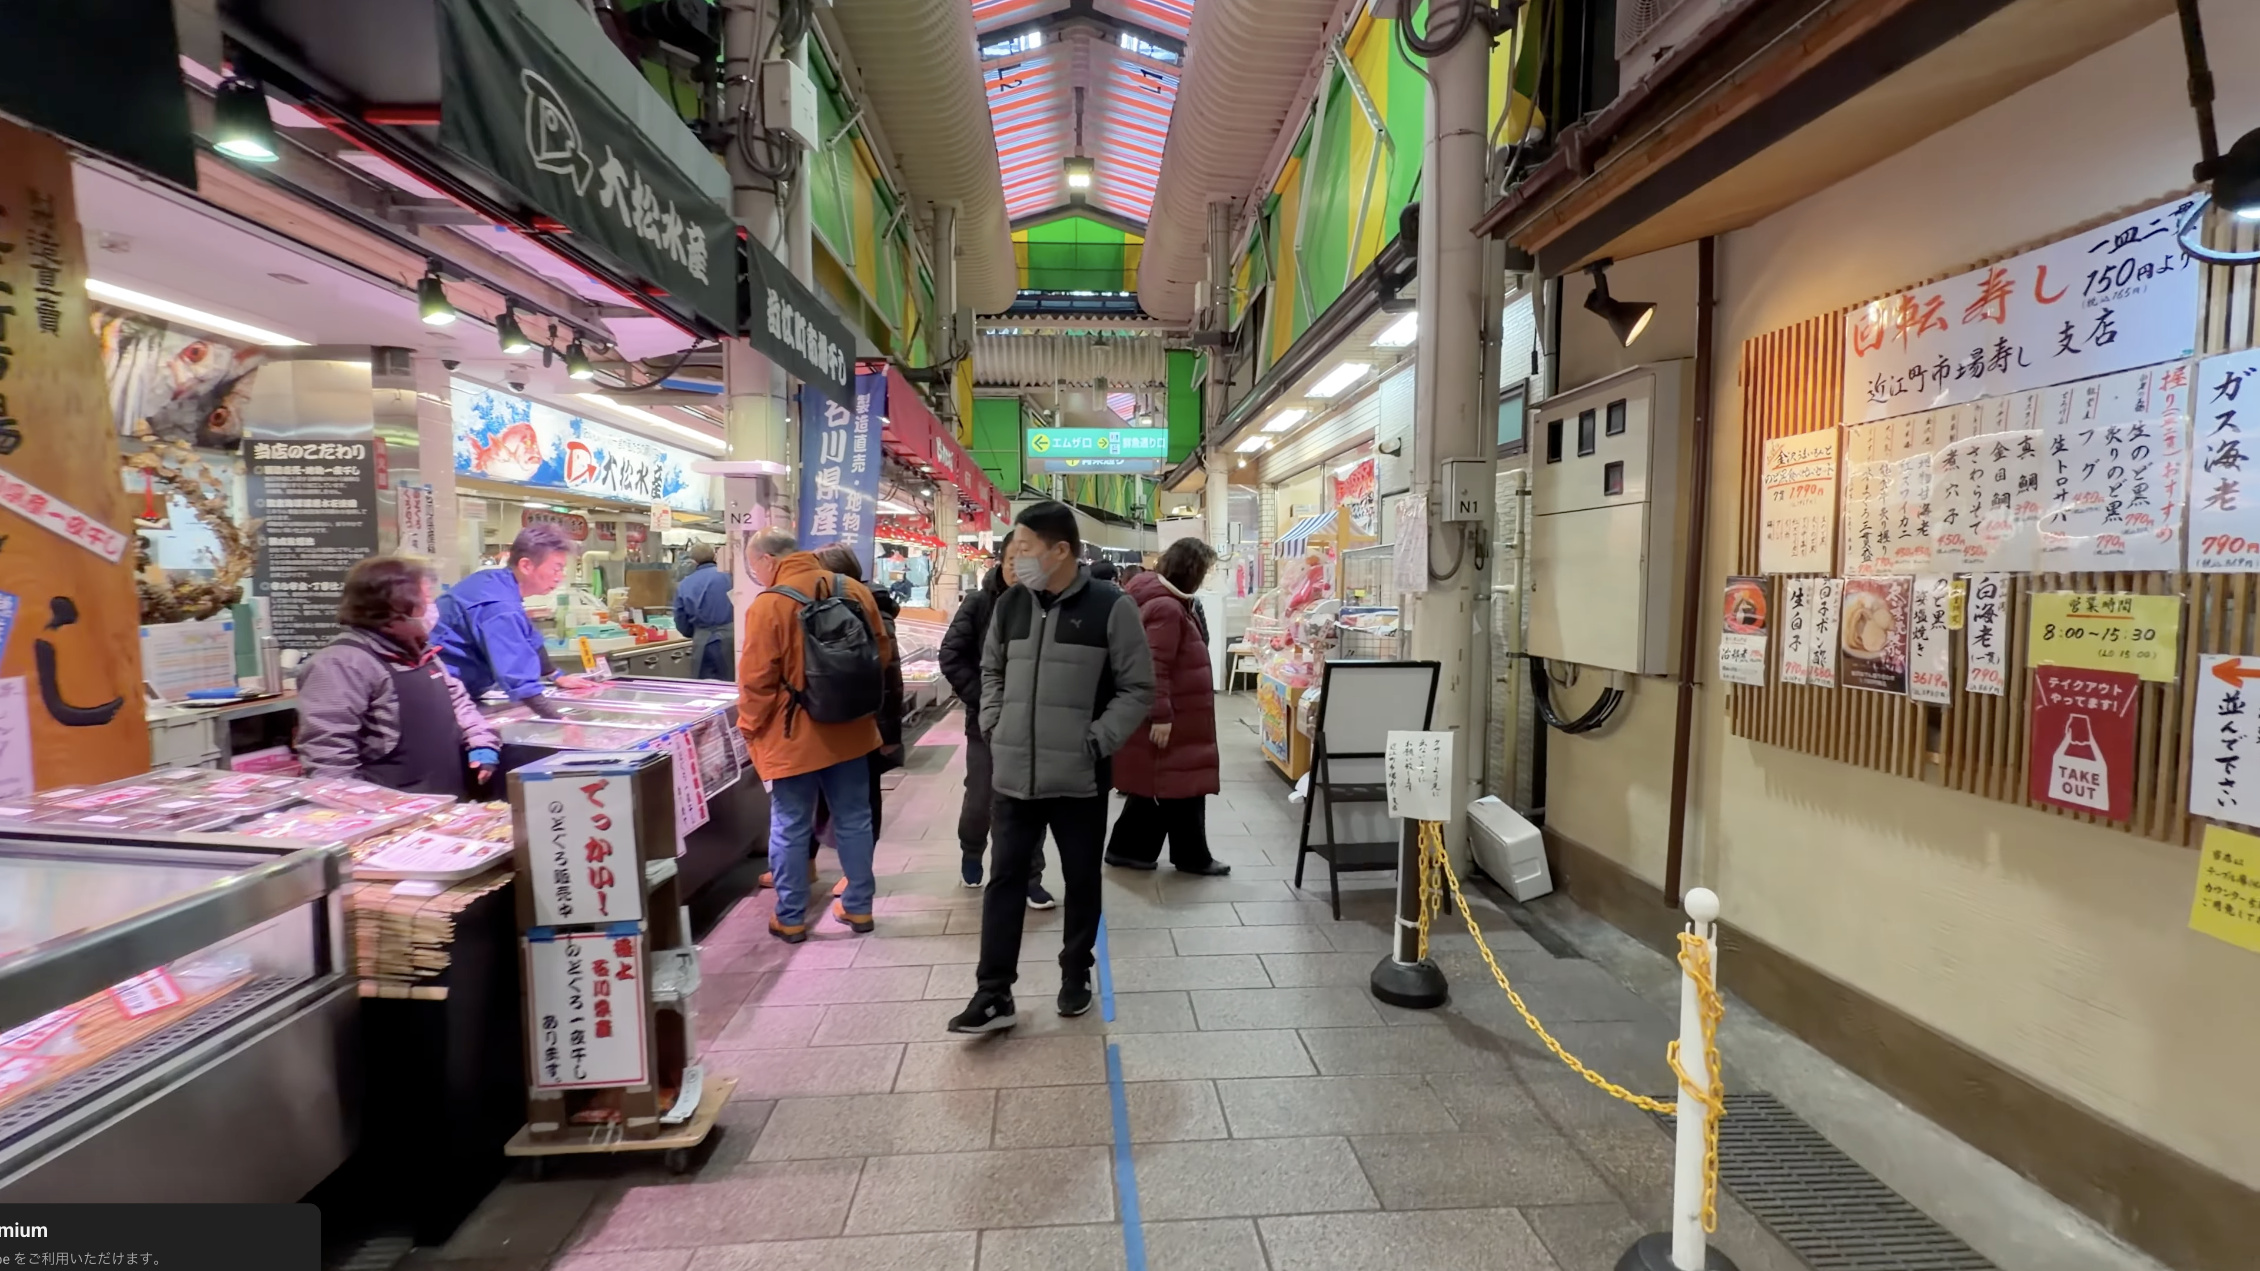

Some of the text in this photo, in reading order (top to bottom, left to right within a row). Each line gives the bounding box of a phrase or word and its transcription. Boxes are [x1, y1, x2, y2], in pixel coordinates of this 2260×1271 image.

[599, 144, 709, 286] 大松水産
[1853, 264, 2070, 358] 回転寿し
[1866, 307, 2118, 404] 近江町市場寿し 支店
[254, 442, 366, 460] 当店のこだわり
[2015, 435, 2039, 497] 真鯛
[2078, 429, 2101, 481] フグ
[2127, 420, 2153, 510] 生のど黒
[2190, 368, 2257, 512] ガス海老
[602, 450, 664, 499] 大松水産
[1942, 449, 1960, 526] 煮穴子
[1989, 441, 2012, 511] 金目鯛
[2050, 434, 2072, 525] 生トロサバ
[2101, 425, 2127, 525] 炙りのど黒
[730, 513, 752, 525] N2
[1459, 501, 1479, 514] N1
[1789, 587, 1804, 652] 生白子
[1972, 577, 1999, 648] 白海老
[2068, 598, 2132, 613] 営業時間
[2048, 677, 2124, 696] テイクアウト
[2058, 765, 2100, 787] TAKE
[2062, 782, 2096, 800] OUT
